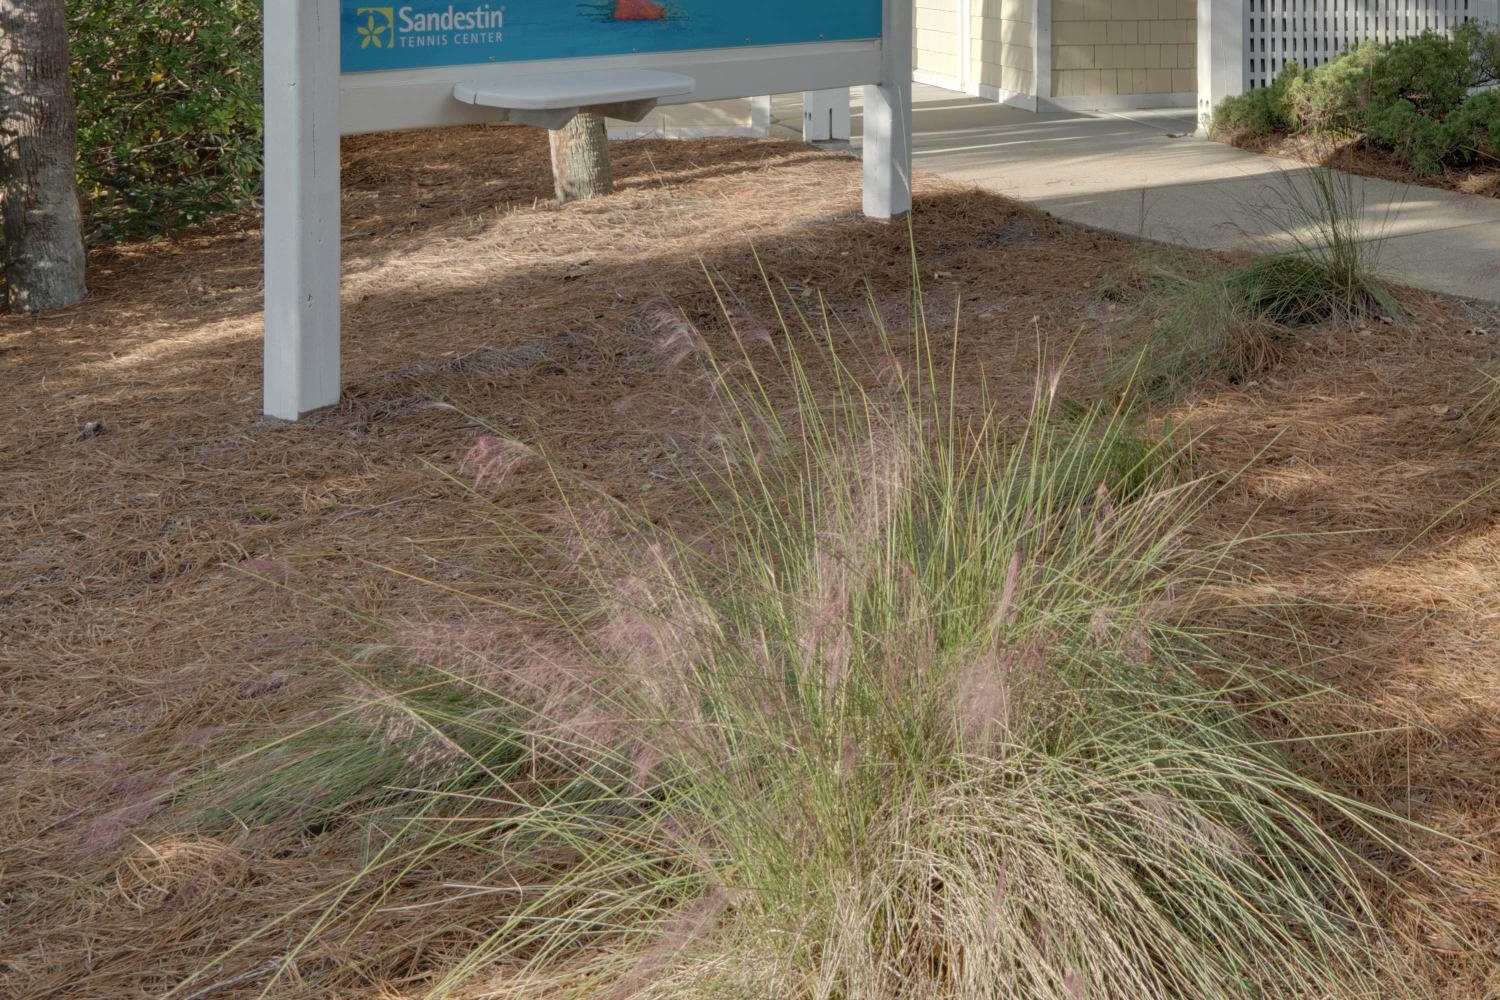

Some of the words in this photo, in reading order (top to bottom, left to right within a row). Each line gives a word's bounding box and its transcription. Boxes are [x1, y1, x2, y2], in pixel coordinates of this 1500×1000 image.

[398, 4, 503, 33] Sandestin
[400, 34, 448, 48] TENNIS
[454, 31, 503, 45] CENTER
